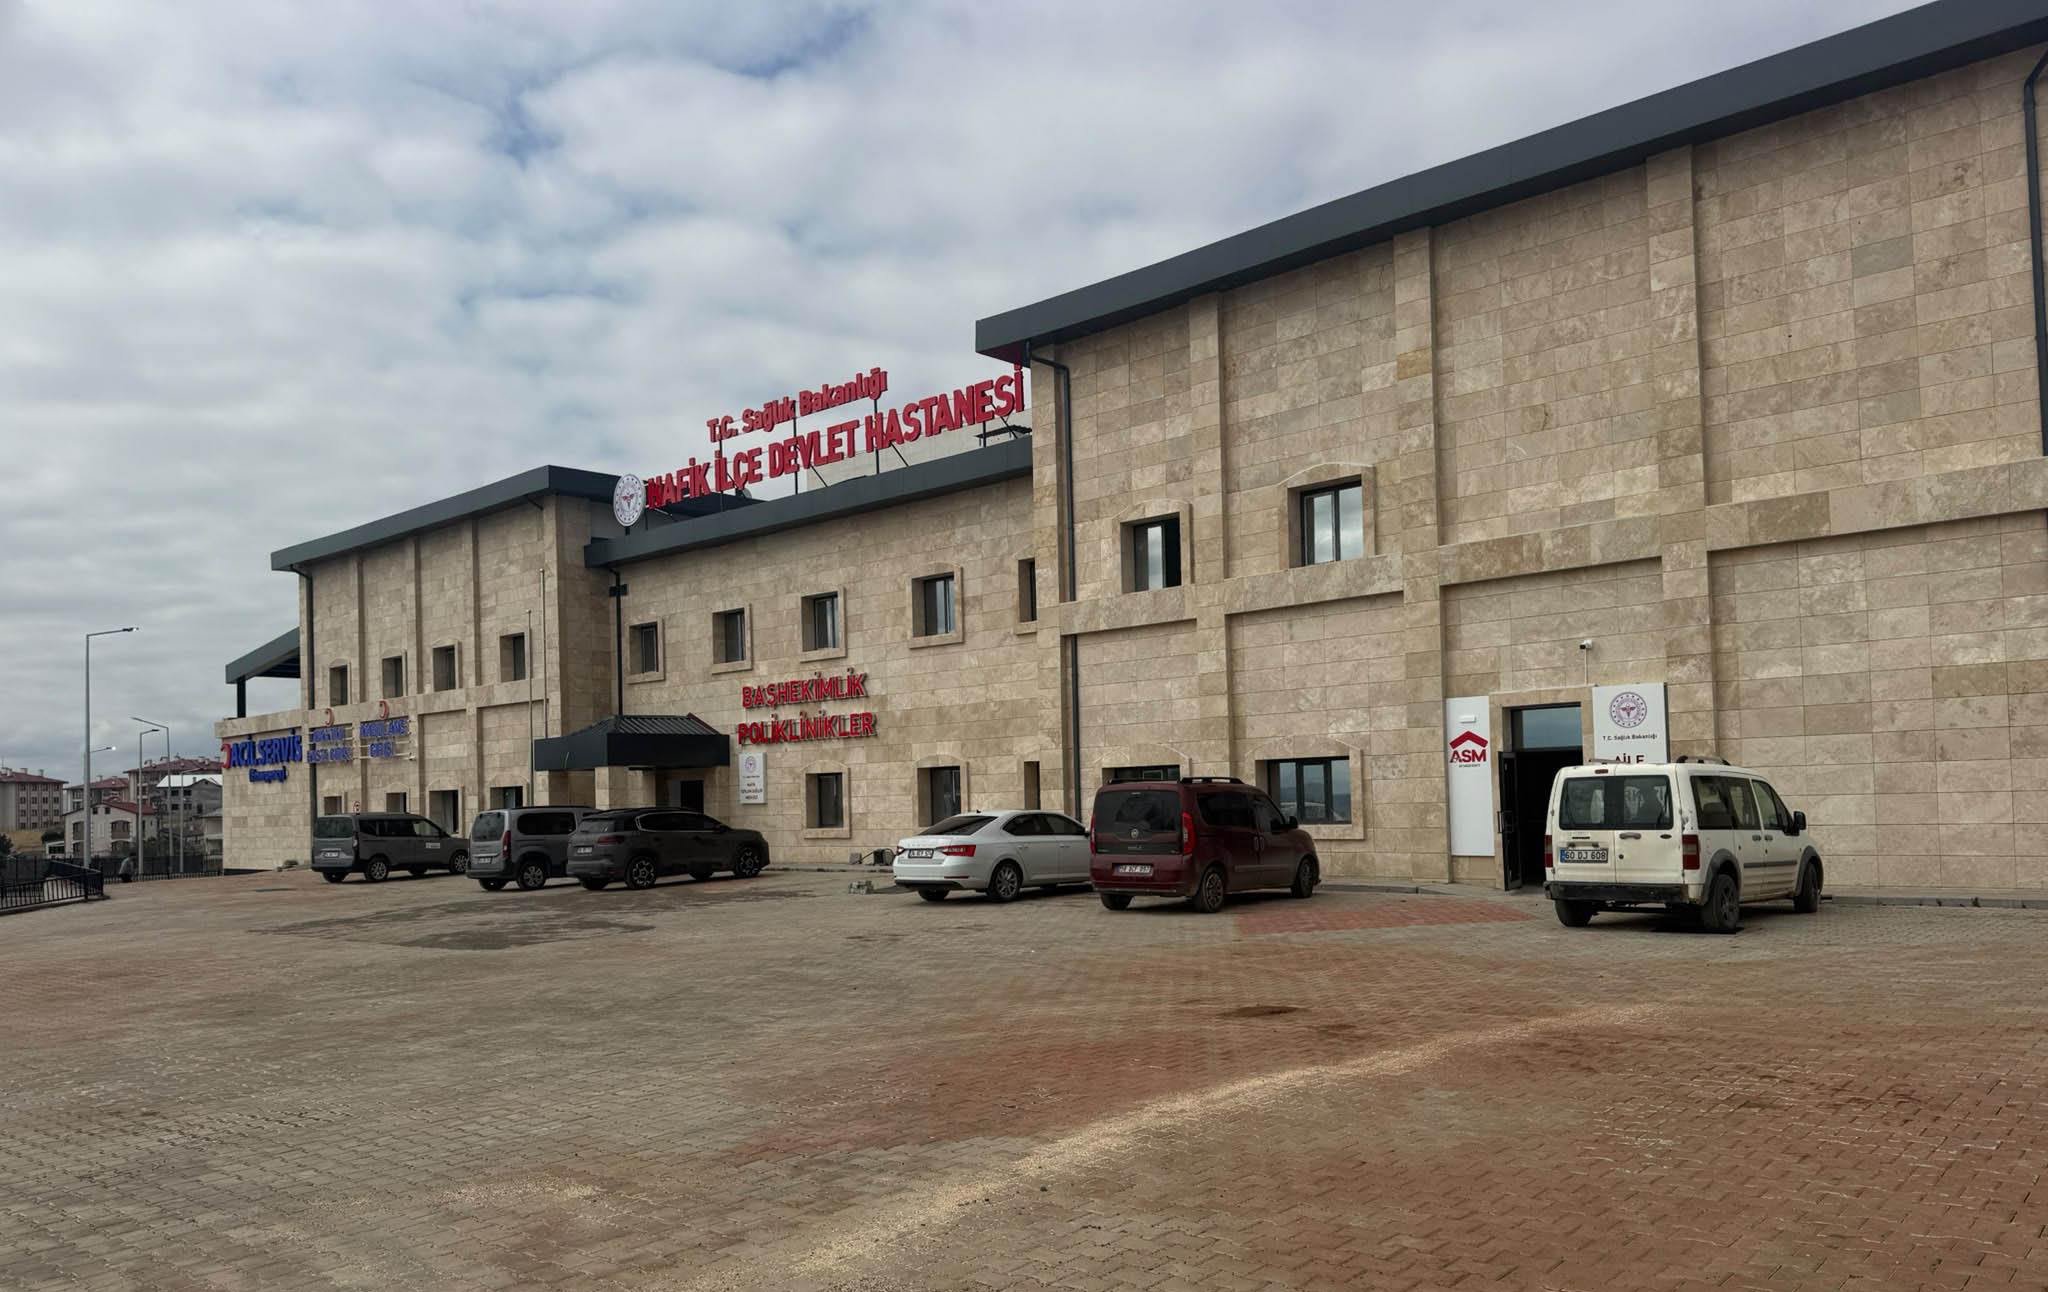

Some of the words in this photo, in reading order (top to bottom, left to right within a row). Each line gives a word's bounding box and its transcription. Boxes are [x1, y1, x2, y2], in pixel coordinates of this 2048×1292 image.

[706, 415, 739, 443] T.C.
[742, 396, 796, 432] Sağlık
[799, 367, 888, 416] Bakanlığı
[647, 457, 711, 510] HAFİK
[714, 450, 763, 492] İLÇE
[768, 419, 860, 479] DEVLET
[865, 363, 1025, 454] HASTANESİ
[742, 667, 867, 708] BAŞHEKİMLİK
[737, 710, 877, 744] POLİKLİNİKLER
[1631, 733, 1658, 741] Bakanlığı
[231, 734, 258, 768] ACİL
[257, 728, 302, 765] SERVİS
[1449, 748, 1487, 763] ASM
[1565, 851, 1575, 860] 60
[1577, 851, 1588, 860] DJ
